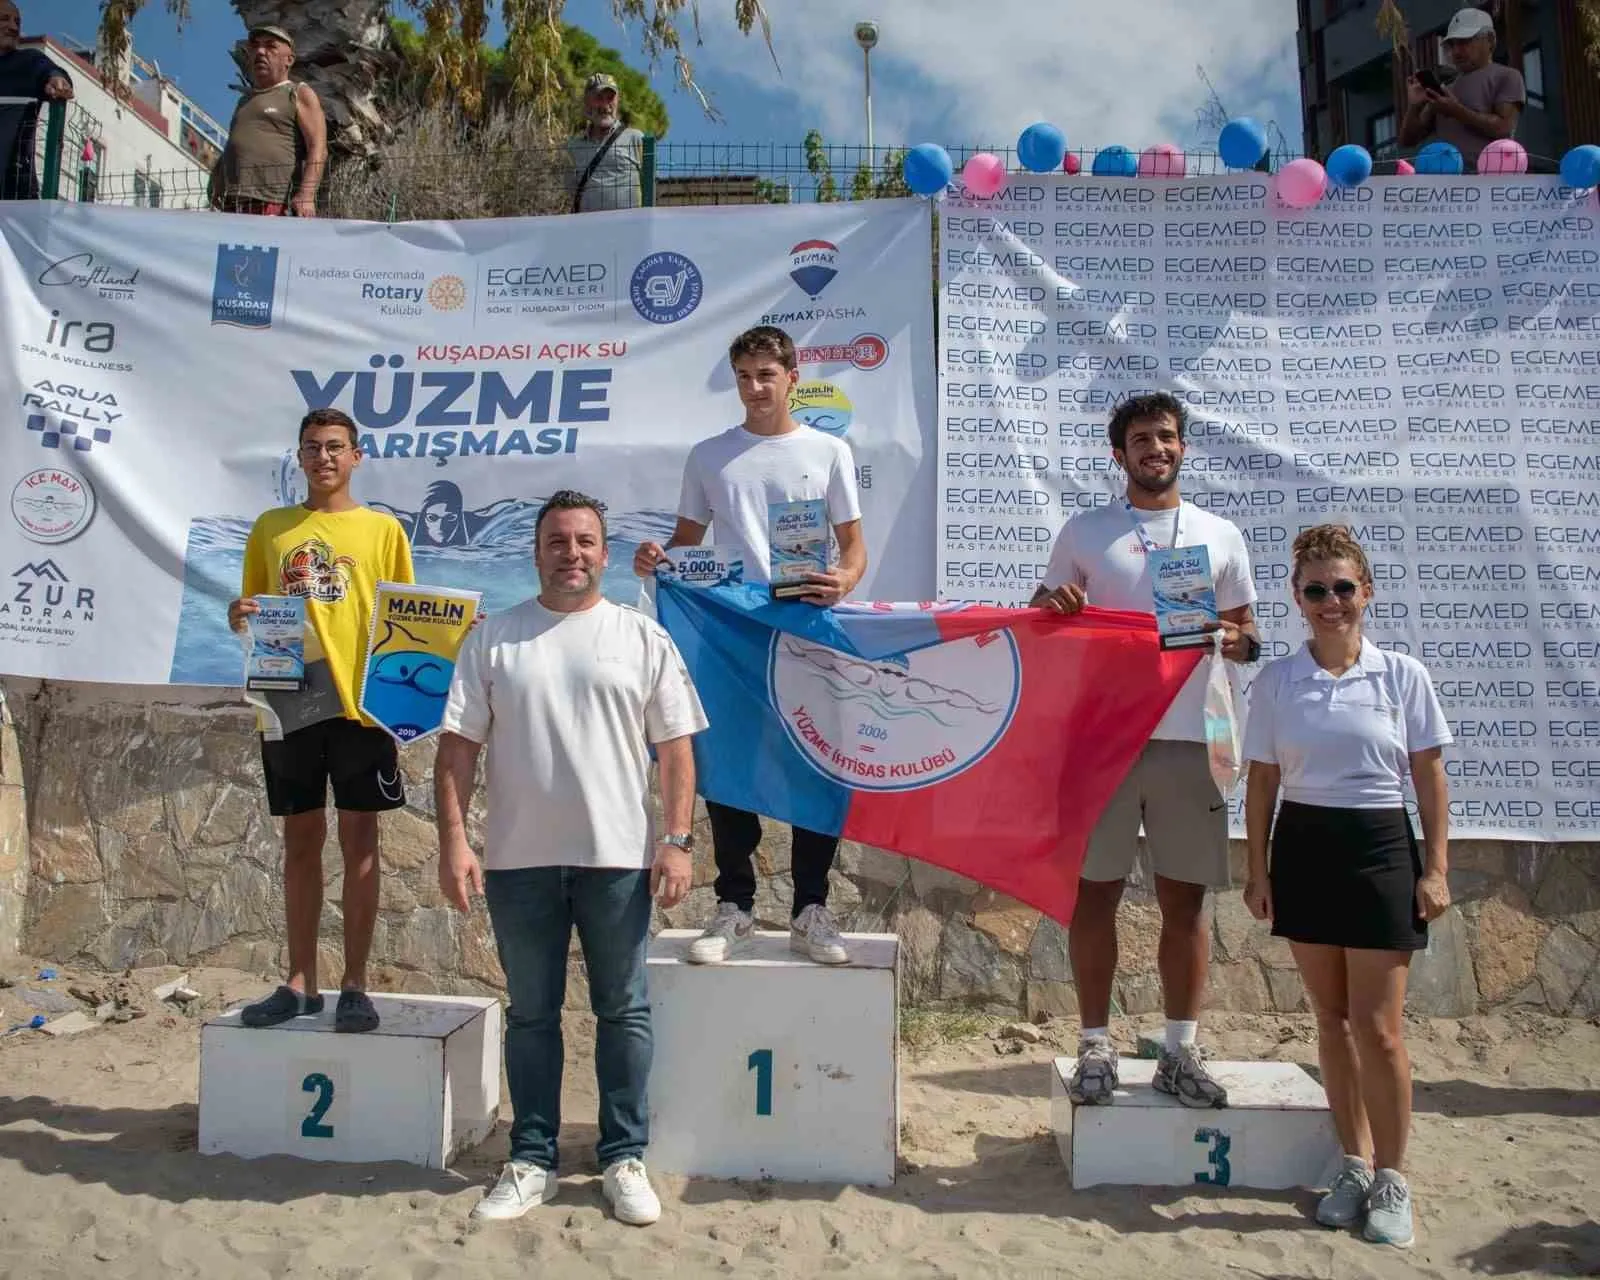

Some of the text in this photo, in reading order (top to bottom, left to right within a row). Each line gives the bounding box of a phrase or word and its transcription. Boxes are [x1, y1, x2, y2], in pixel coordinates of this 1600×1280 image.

[1056, 186, 1155, 203] EGEMED
[1165, 185, 1267, 202] EGEMED
[1384, 187, 1480, 203] EGEMED
[947, 217, 1044, 236] EGEMED
[1054, 222, 1154, 238] EGEMED
[1165, 220, 1266, 238] EGEMED
[1277, 221, 1373, 238] EGEMED
[1383, 223, 1482, 238] EGEMED
[1493, 217, 1593, 236] EGEMED
[793, 253, 834, 265] RE/MAX
[947, 249, 1046, 267] EGEMED
[1056, 256, 1154, 272] EGEMED
[1165, 256, 1266, 273] EGEMED
[1275, 256, 1374, 273] EGEMED
[1384, 256, 1487, 272] EGEMED
[1497, 249, 1599, 268] EGEMED
[488, 263, 607, 285] EGEMED
[99, 292, 134, 300] MEDIA
[362, 283, 423, 303] Rotary
[948, 281, 1046, 301] EGEMED
[1056, 286, 1155, 305] EGEMED
[1165, 292, 1266, 308] EGEMED
[1276, 292, 1377, 308] EGEMED
[1388, 288, 1492, 305] EGEMED
[46, 310, 115, 353] ira
[947, 313, 1046, 335] EGEMED
[1056, 320, 1157, 338] EGEMED
[1278, 324, 1382, 340] EGEMED
[1392, 317, 1498, 336] EGEMED
[1168, 325, 1268, 342] EGEMED
[21, 344, 48, 358] SPA
[63, 357, 133, 372] WELLNESS
[417, 342, 627, 365] KUŞADASI AÇIK SU
[947, 349, 1048, 368] EGEMED
[1056, 354, 1159, 371] EGEMED
[1397, 348, 1501, 368] EGEMED
[1169, 357, 1271, 374] EGEMED
[1282, 356, 1387, 372] EGEMED
[34, 379, 118, 406] AQUA
[290, 354, 613, 429] YÜZME
[946, 382, 1048, 402] EGEMED
[1285, 385, 1392, 404] EGEMED
[1402, 382, 1504, 401] EGEMED
[23, 393, 122, 423] RALLY
[945, 416, 1048, 436] EGEMED
[1289, 419, 1397, 436] EGEMED
[1408, 416, 1510, 433] EGEMED
[360, 428, 578, 467] ARIŞMASI
[946, 452, 1050, 471] EGEMED
[1294, 450, 1399, 467] EGEMED
[1410, 453, 1516, 469] EGEMED
[25, 473, 80, 492] ICE MAN
[946, 488, 1050, 506] EGEMED
[1296, 486, 1405, 504] EGEMED
[1415, 488, 1520, 504] EGEMED
[804, 511, 817, 521] SU
[946, 524, 1052, 542] EGEMED
[1416, 526, 1524, 542] EGEMED
[946, 562, 1048, 580] EGEMED
[1185, 559, 1200, 568] SU
[1418, 564, 1526, 580] EGEMED
[284, 609, 296, 618] SU
[388, 598, 464, 618] MARLİN
[1419, 602, 1528, 619] EGEMED
[1422, 642, 1531, 658] EGEMED
[1432, 681, 1534, 697] GEMED
[397, 727, 417, 737] 2019
[857, 723, 888, 741] 2006
[791, 705, 957, 778] YÜZME İHTİSAS KULÜBÜ
[1444, 760, 1541, 777] GEMED
[1448, 800, 1543, 817] GEMED
[748, 1048, 773, 1116] 1
[301, 1072, 335, 1138] 2
[1194, 1127, 1231, 1187] 3
